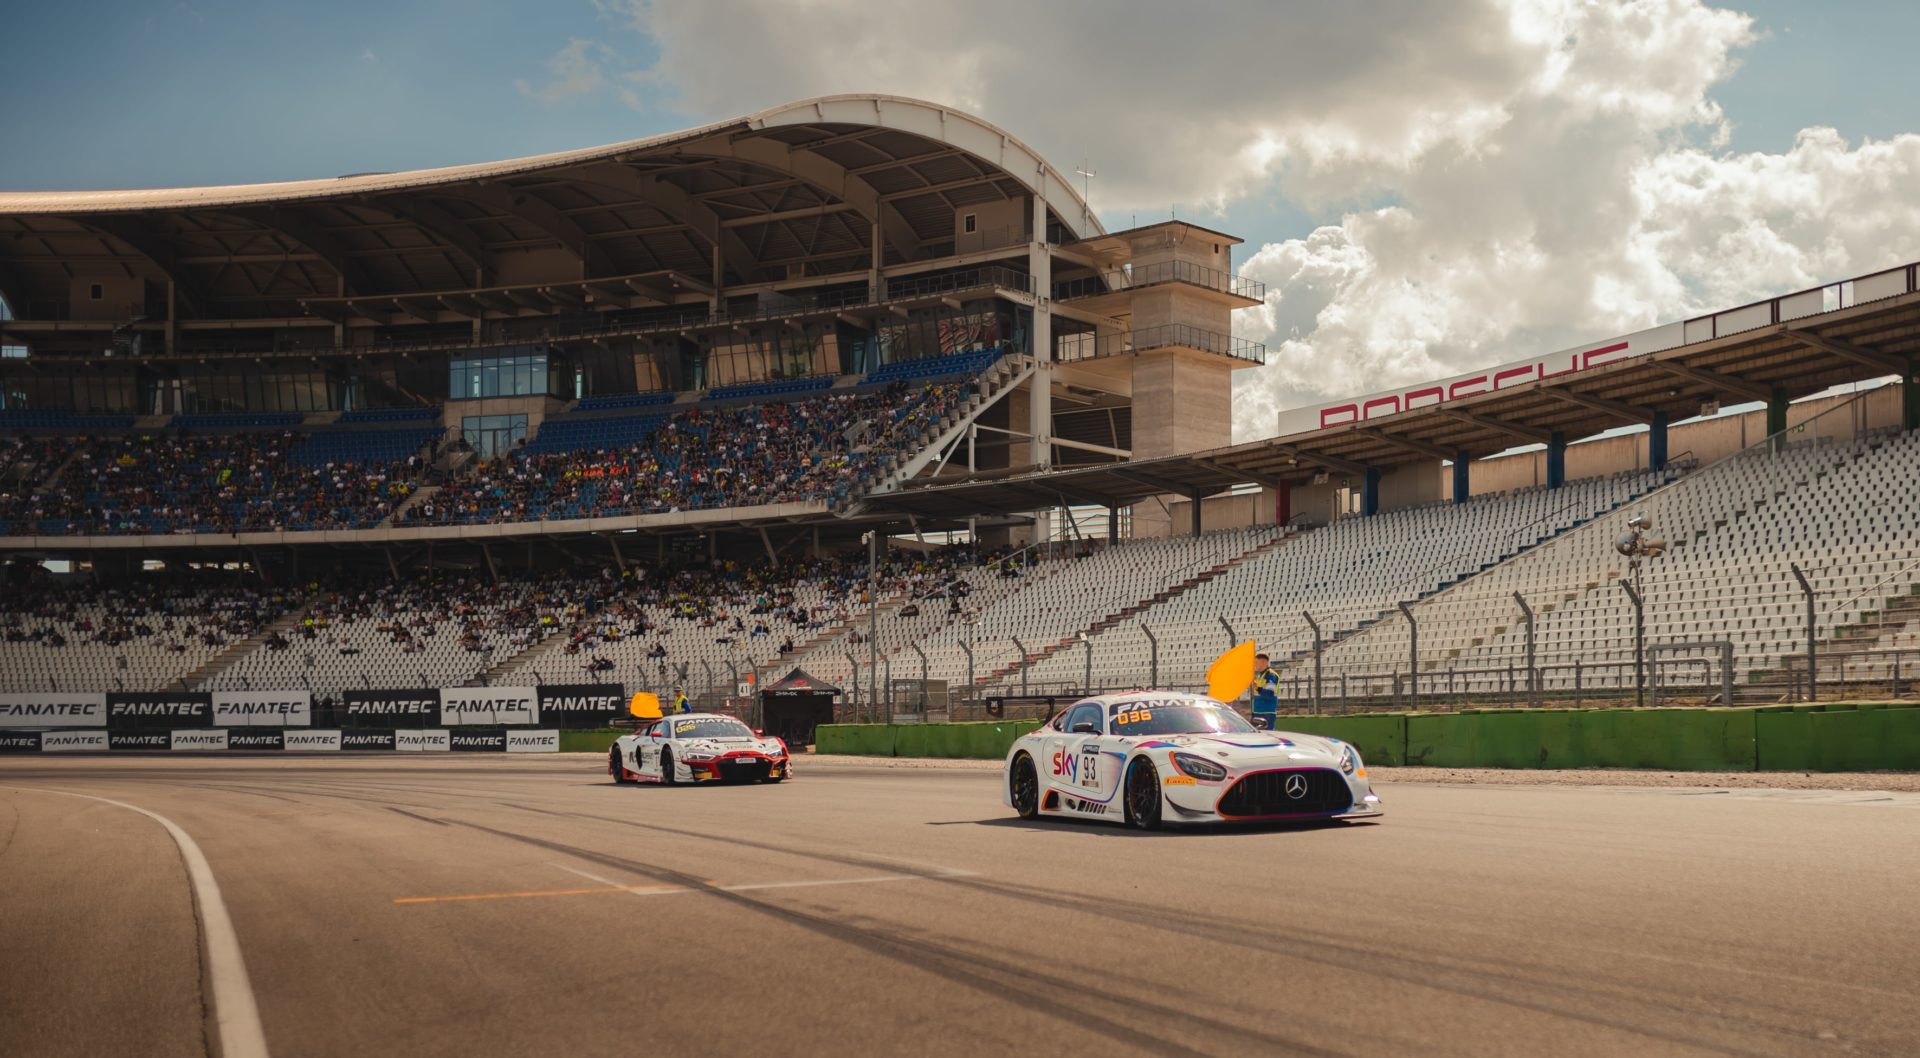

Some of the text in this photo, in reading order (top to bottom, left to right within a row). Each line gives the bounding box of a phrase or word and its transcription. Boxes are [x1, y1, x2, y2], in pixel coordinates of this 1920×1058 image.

[740, 685, 748, 694] 41
[111, 702, 205, 716] FANATEC
[217, 702, 303, 715] FANATEC
[348, 700, 433, 714] FANATEC
[445, 698, 531, 713] FANATEC
[542, 696, 619, 711] FANATEC
[1117, 700, 1222, 714] FANATEC
[0, 703, 98, 716] FANATEC
[1118, 709, 1152, 725] 036
[44, 736, 104, 745] FANATEC
[111, 735, 168, 745] FANATEC
[174, 735, 225, 744] FANATEC
[230, 736, 282, 745] FANATEC
[286, 735, 338, 745] FANATEC
[342, 735, 393, 745] FANATEC
[397, 736, 447, 745] FANATEC
[451, 736, 503, 746] FANATEC
[508, 736, 556, 746] FANATEC
[1053, 745, 1079, 784] sky
[1083, 756, 1096, 780] 93
